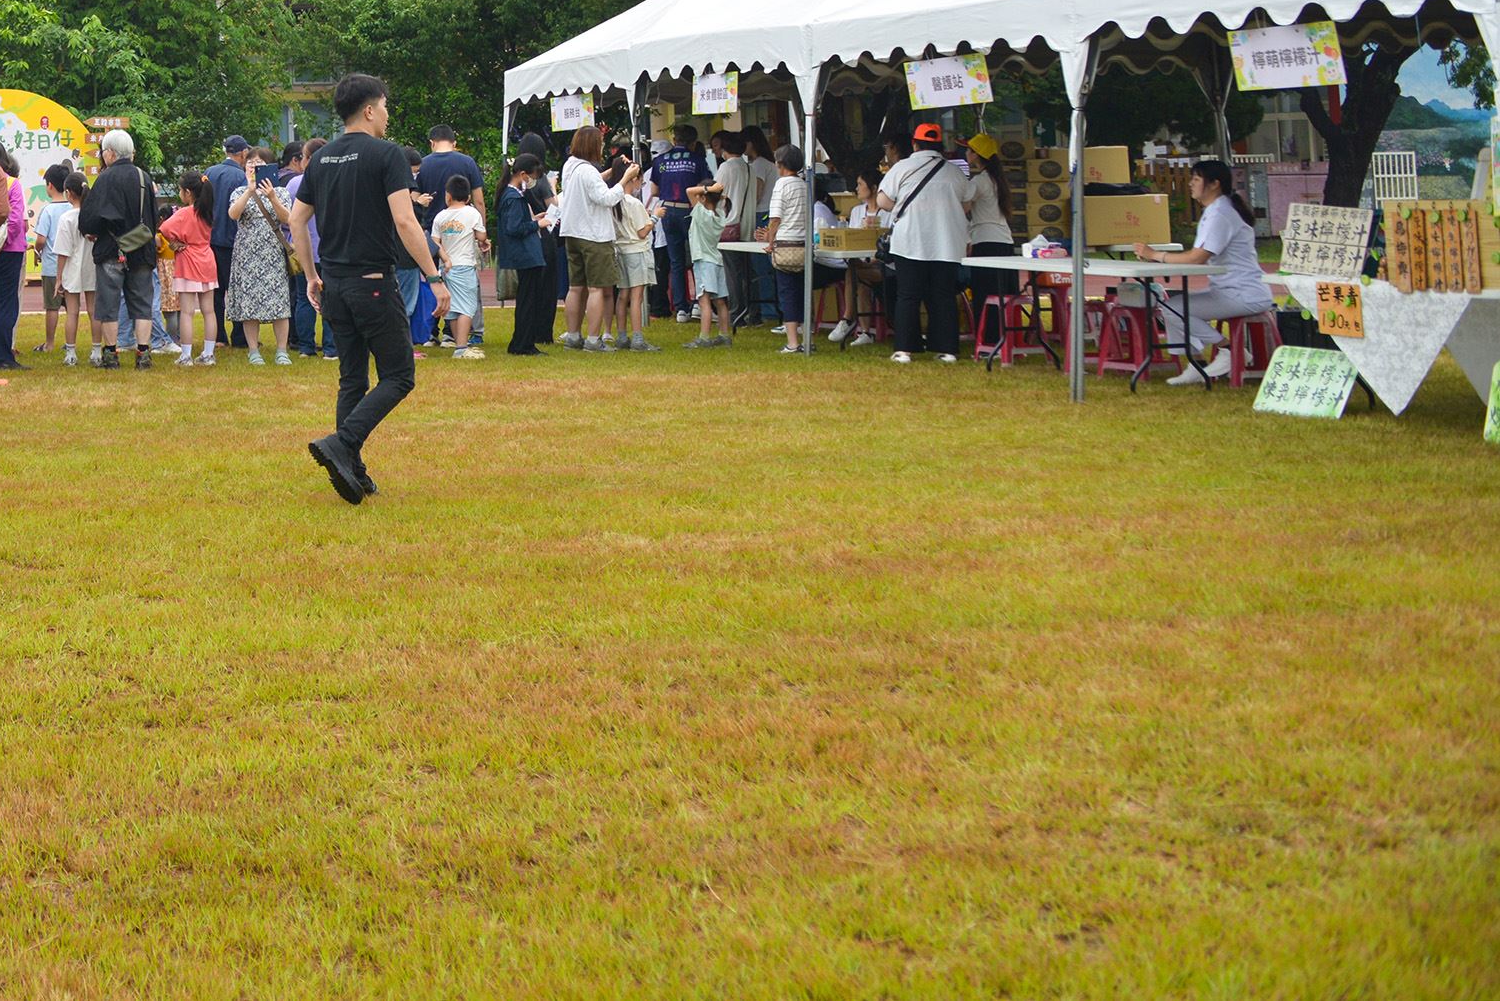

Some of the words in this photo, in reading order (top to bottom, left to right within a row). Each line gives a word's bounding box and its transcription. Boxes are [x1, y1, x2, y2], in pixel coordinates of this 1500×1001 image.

[1251, 47, 1320, 69] 檸萌檸檬汁
[931, 74, 964, 92] 醫護站
